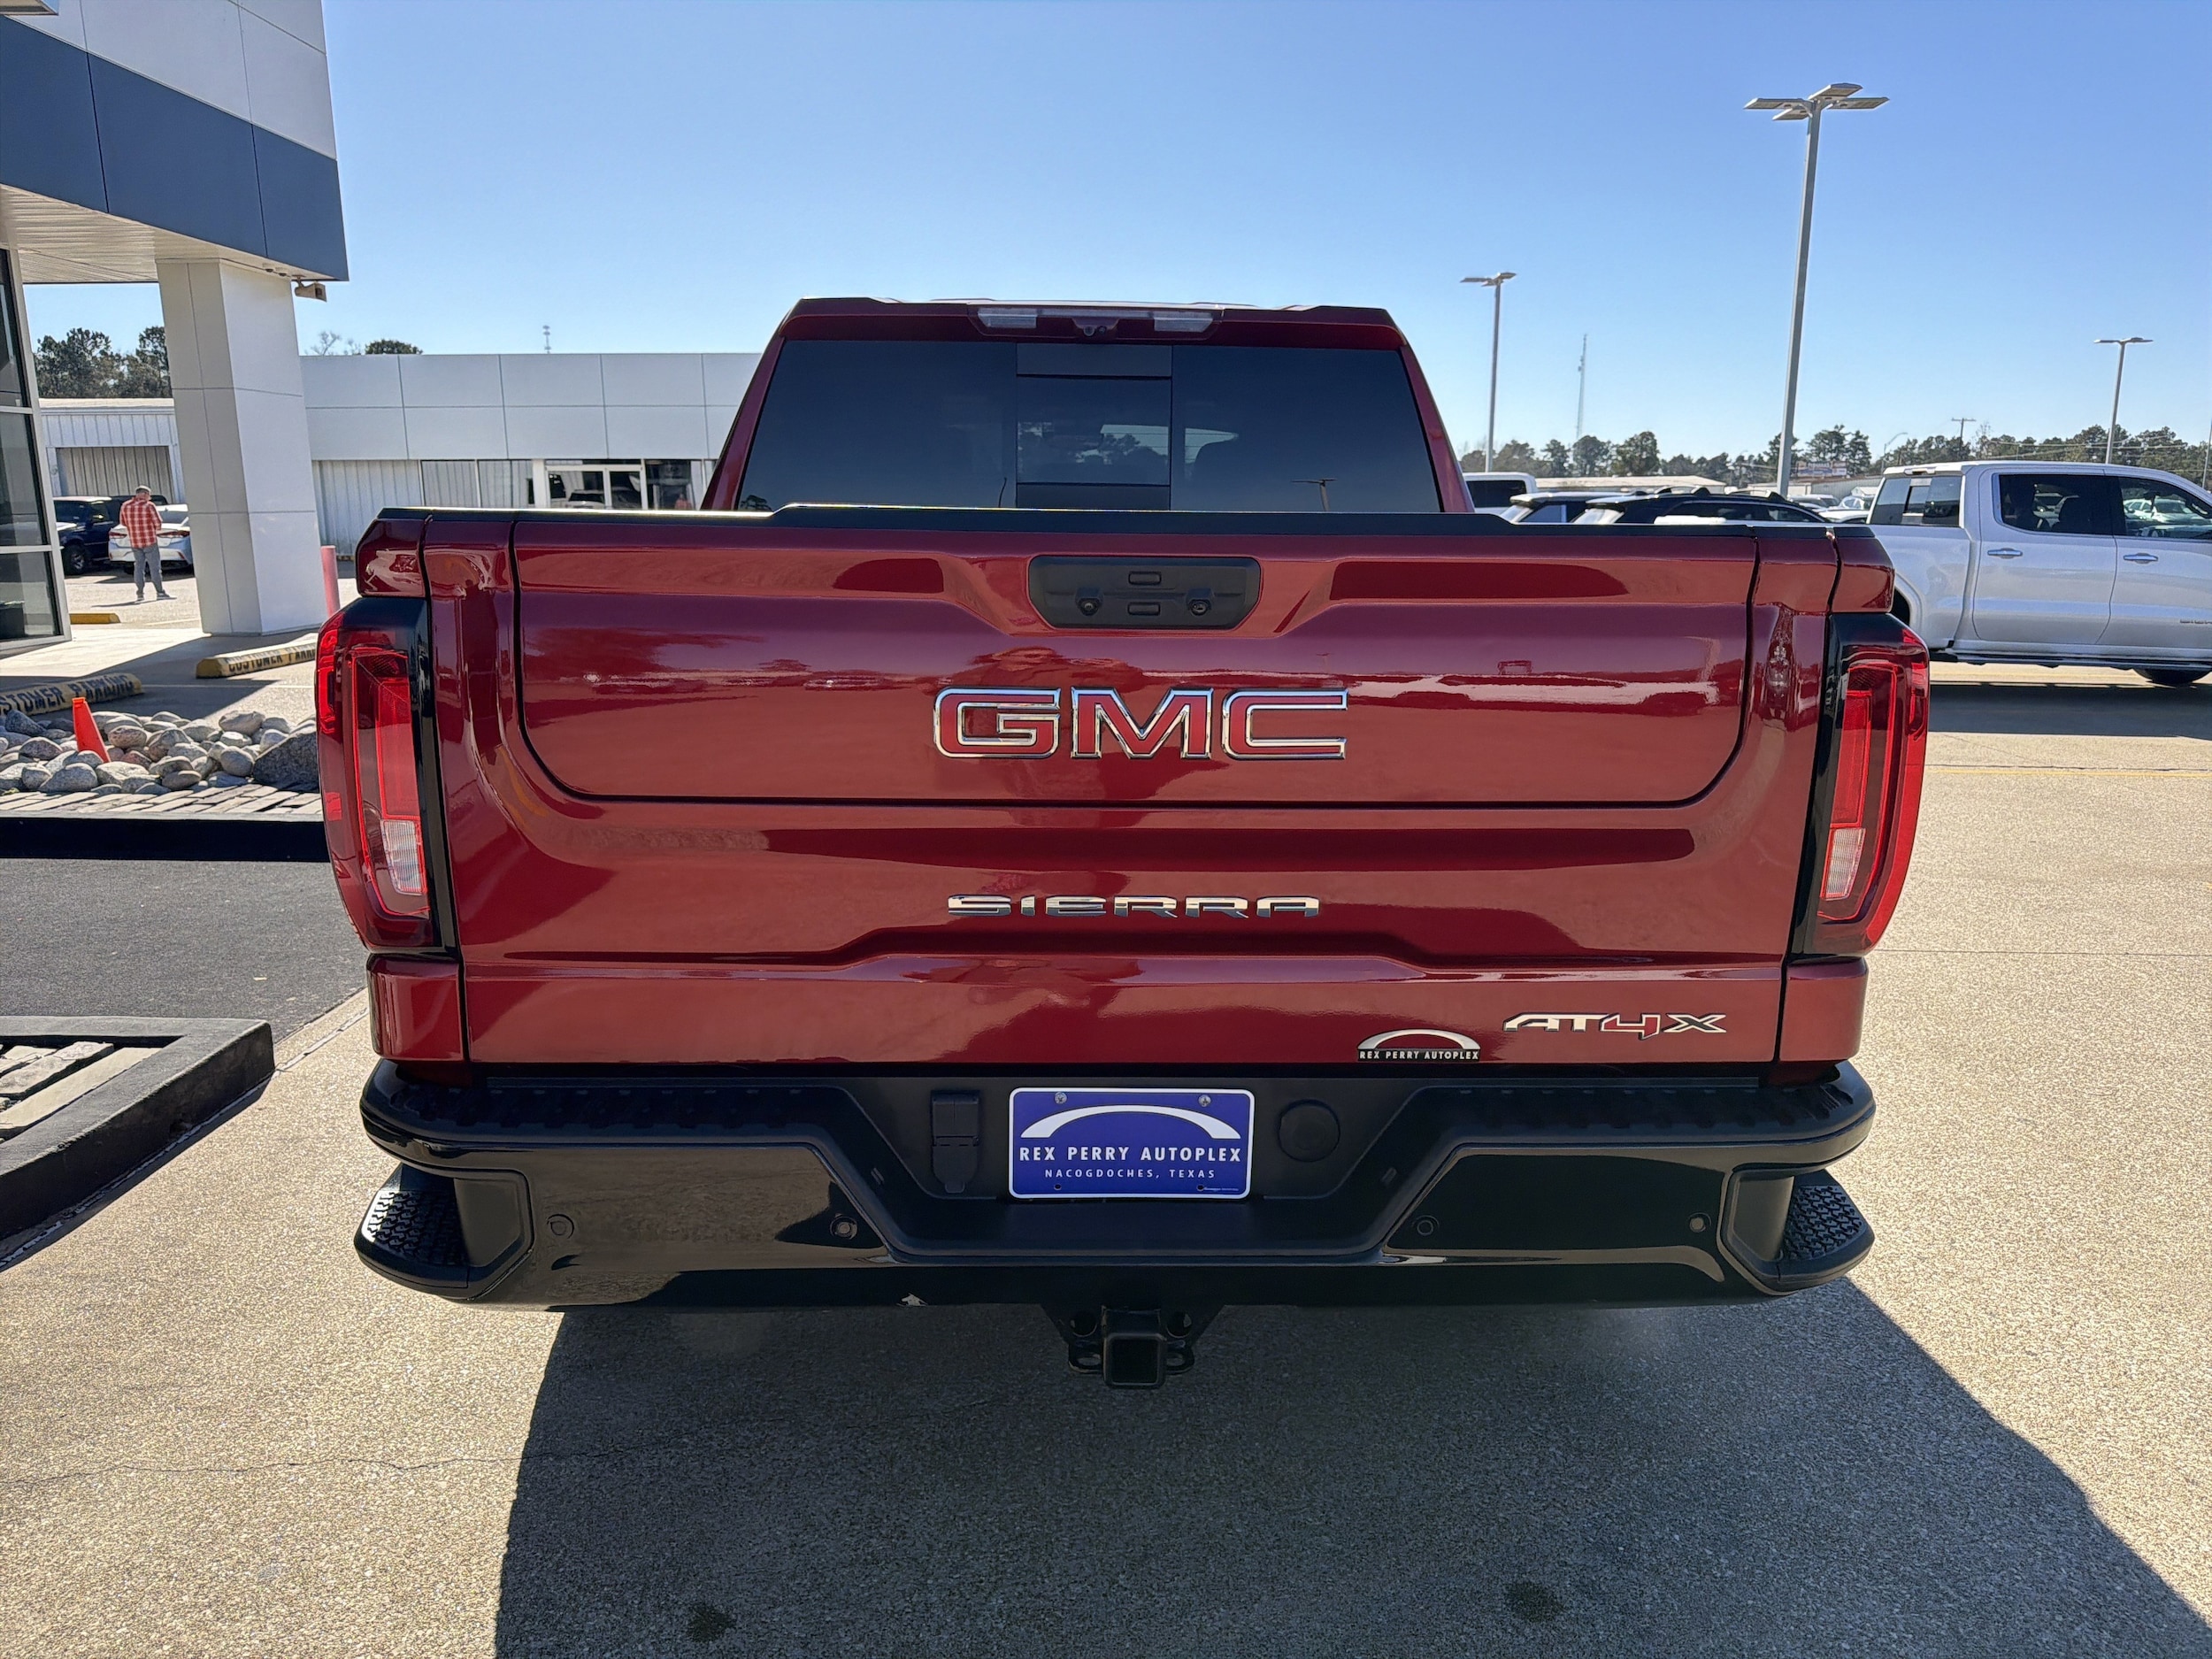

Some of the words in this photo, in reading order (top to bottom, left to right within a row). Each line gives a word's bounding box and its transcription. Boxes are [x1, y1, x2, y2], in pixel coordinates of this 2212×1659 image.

[0, 687, 65, 715] STOMER
[933, 687, 1348, 759] GMC
[948, 895, 1319, 918] SIERRA
[1503, 1013, 1726, 1040] AT4X
[1386, 1051, 1418, 1060] PERRY
[1424, 1051, 1479, 1060] AUTOPLEX
[1019, 1147, 1056, 1161] REX
[1067, 1147, 1129, 1161] PERRY
[1141, 1148, 1240, 1162] AUTOPLEX
[1045, 1169, 1160, 1179] NACOGDOCHES,
[1170, 1170, 1215, 1179] TEXAS
